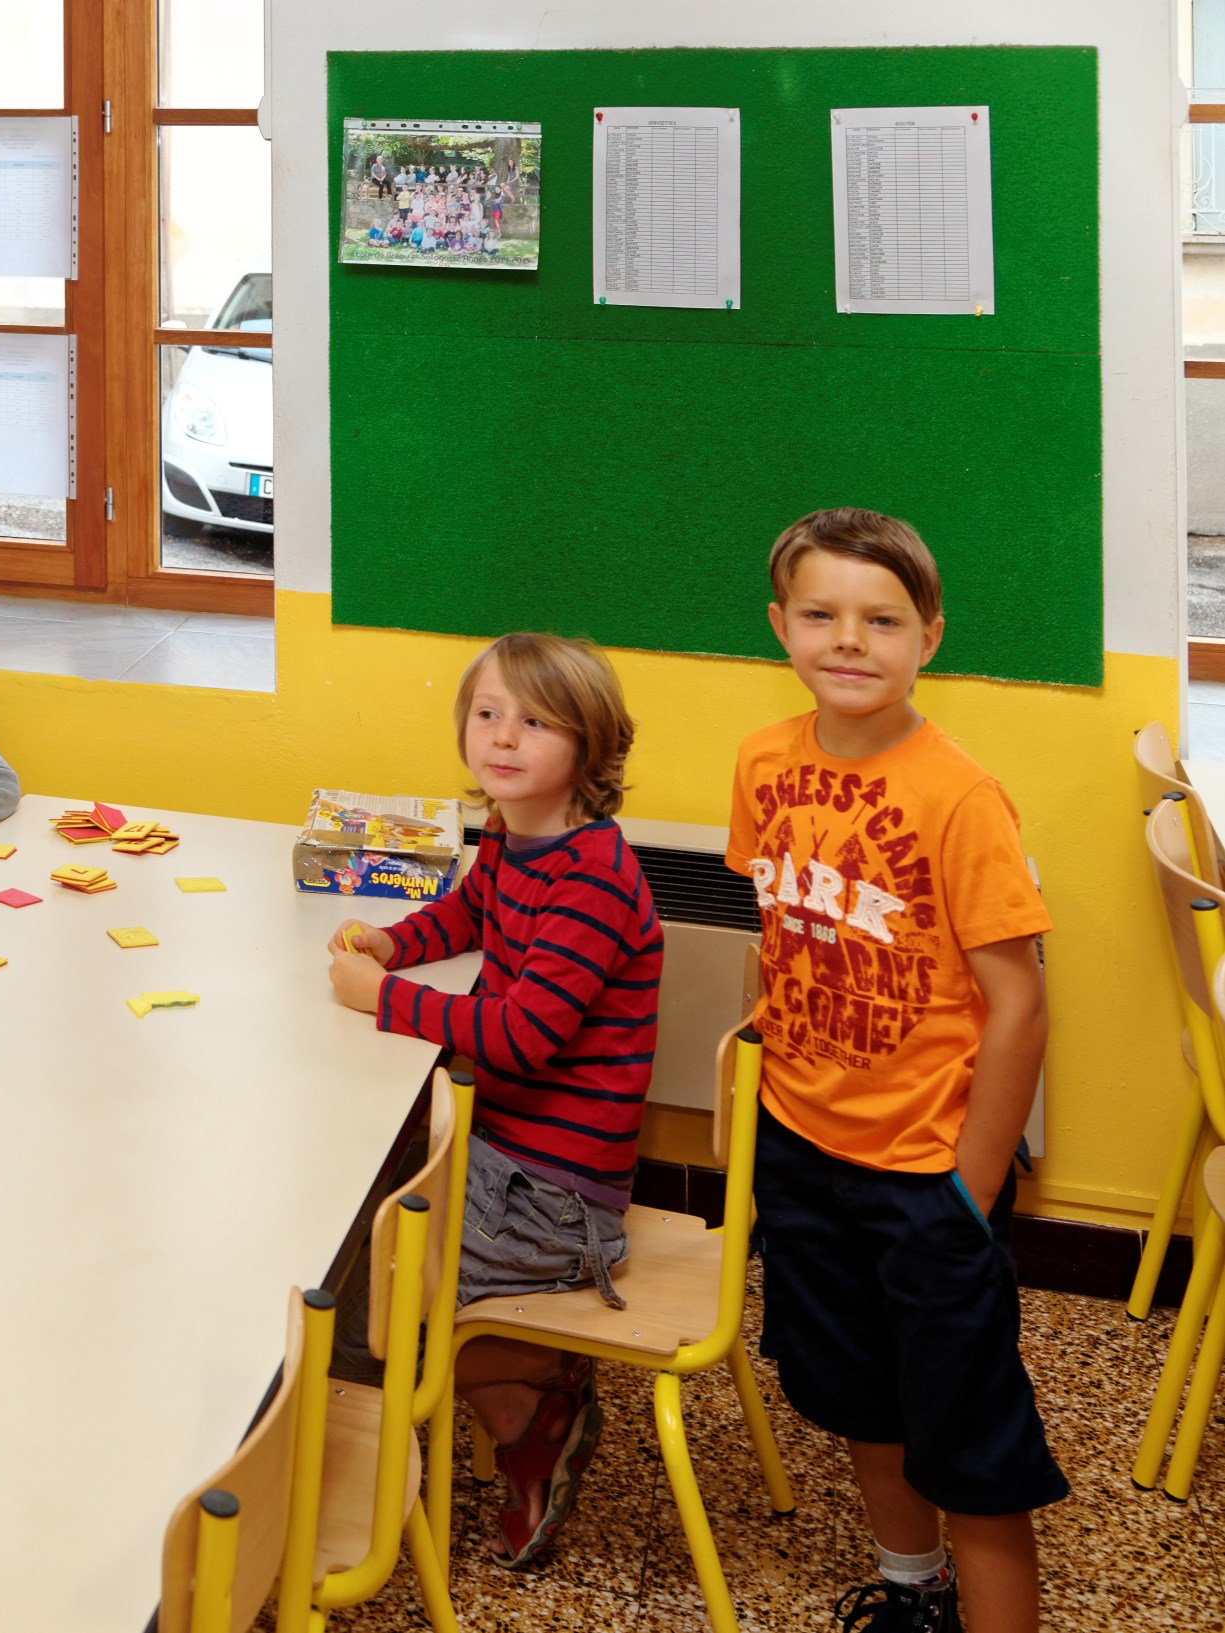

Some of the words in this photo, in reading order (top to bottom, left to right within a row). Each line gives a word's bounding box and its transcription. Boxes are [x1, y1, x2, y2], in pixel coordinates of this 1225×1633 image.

[371, 872, 438, 895] Numéros
[405, 886, 422, 899] Mr.
[751, 852, 905, 944] PARK
[813, 1036, 871, 1070] TOGETHER
